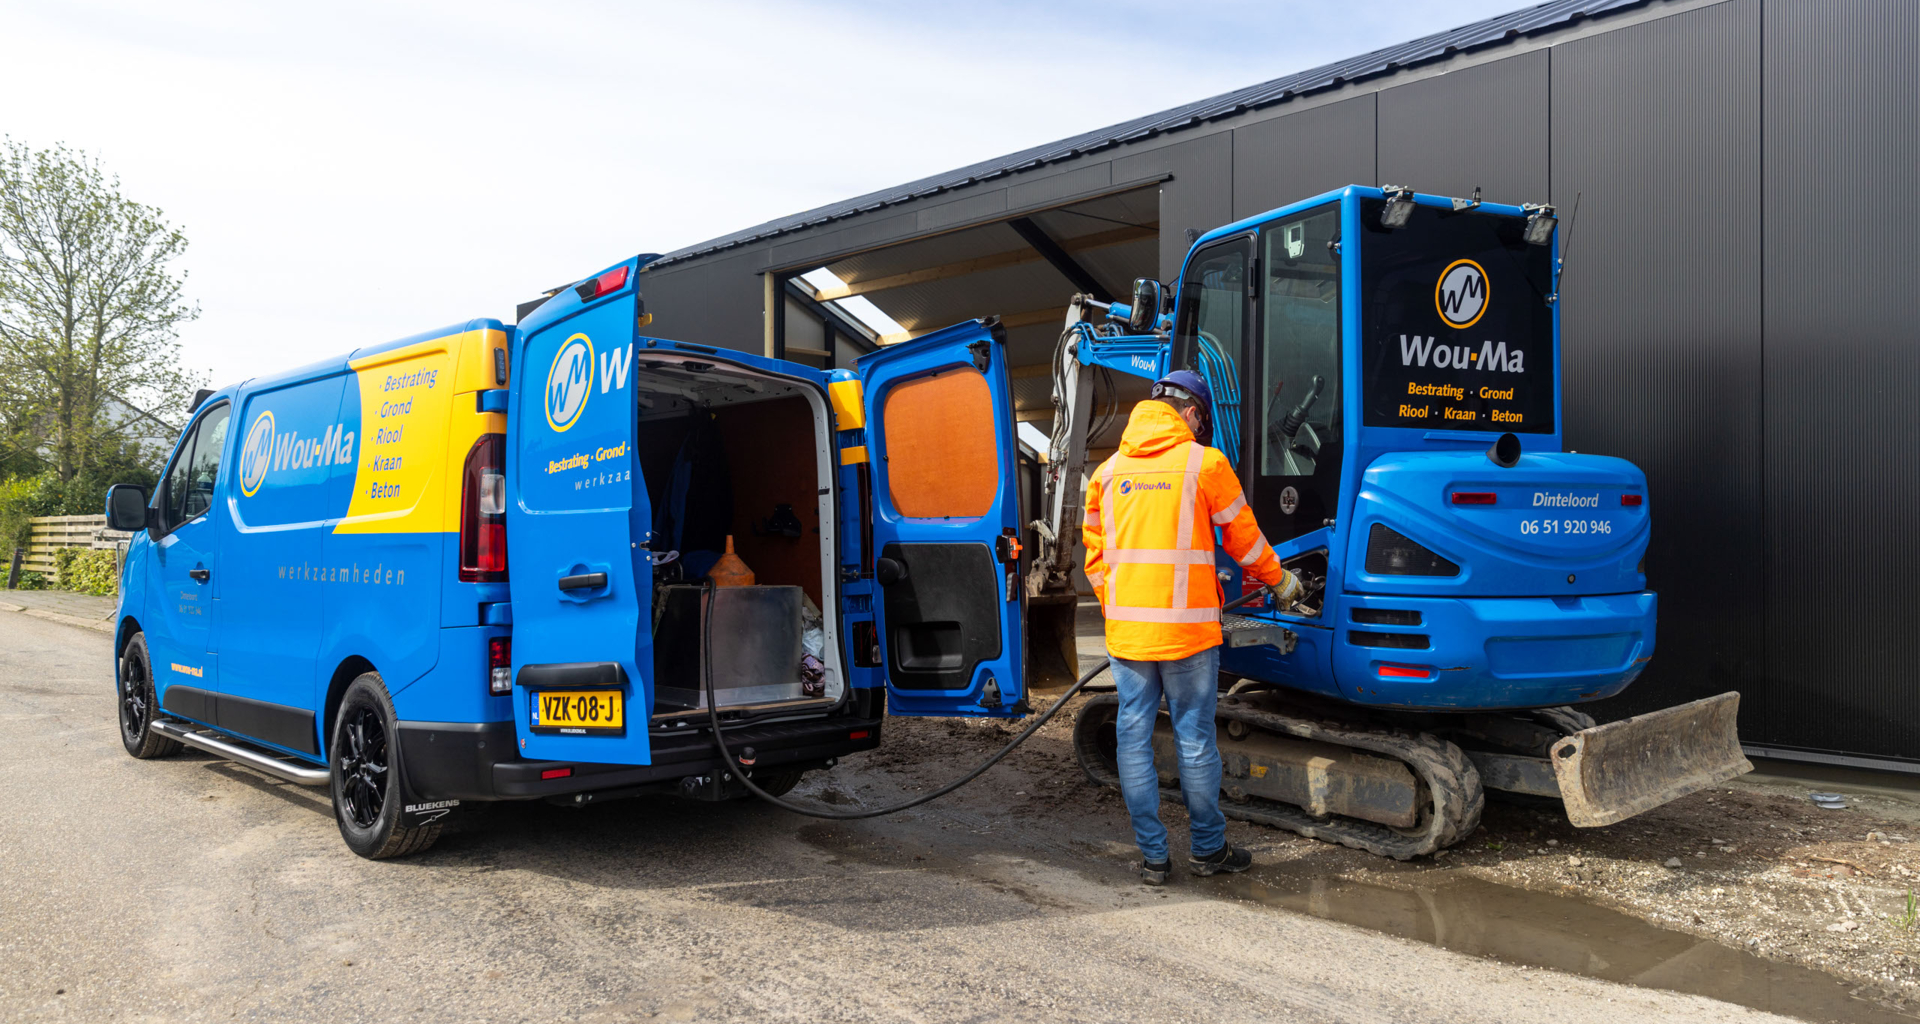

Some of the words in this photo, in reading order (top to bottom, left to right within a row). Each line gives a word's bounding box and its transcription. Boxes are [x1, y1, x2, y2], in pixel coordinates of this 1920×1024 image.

[383, 367, 438, 392] Bestrating
[1407, 382, 1465, 401] Bestrating
[1479, 386, 1514, 400] Grond
[380, 396, 413, 418] Grond
[1398, 404, 1429, 418] Riool
[1444, 407, 1476, 420] Kraan
[1491, 409, 1523, 423] Beton
[375, 424, 404, 445] Riool
[372, 454, 402, 472] Kraan
[548, 453, 590, 474] Bestrating
[595, 441, 626, 462] Grond
[370, 481, 401, 499] Beton
[574, 470, 631, 491] werkzaa
[1532, 492, 1599, 508] Dinteloord
[1520, 520, 1539, 534] 06
[1543, 520, 1558, 533] 51
[1563, 520, 1587, 534] 920
[1590, 520, 1612, 534] 946
[278, 561, 405, 585] werkzaamheden
[532, 712, 539, 720] NL
[543, 695, 614, 722] VZK-08-J
[405, 799, 460, 813] BLUEKENS
